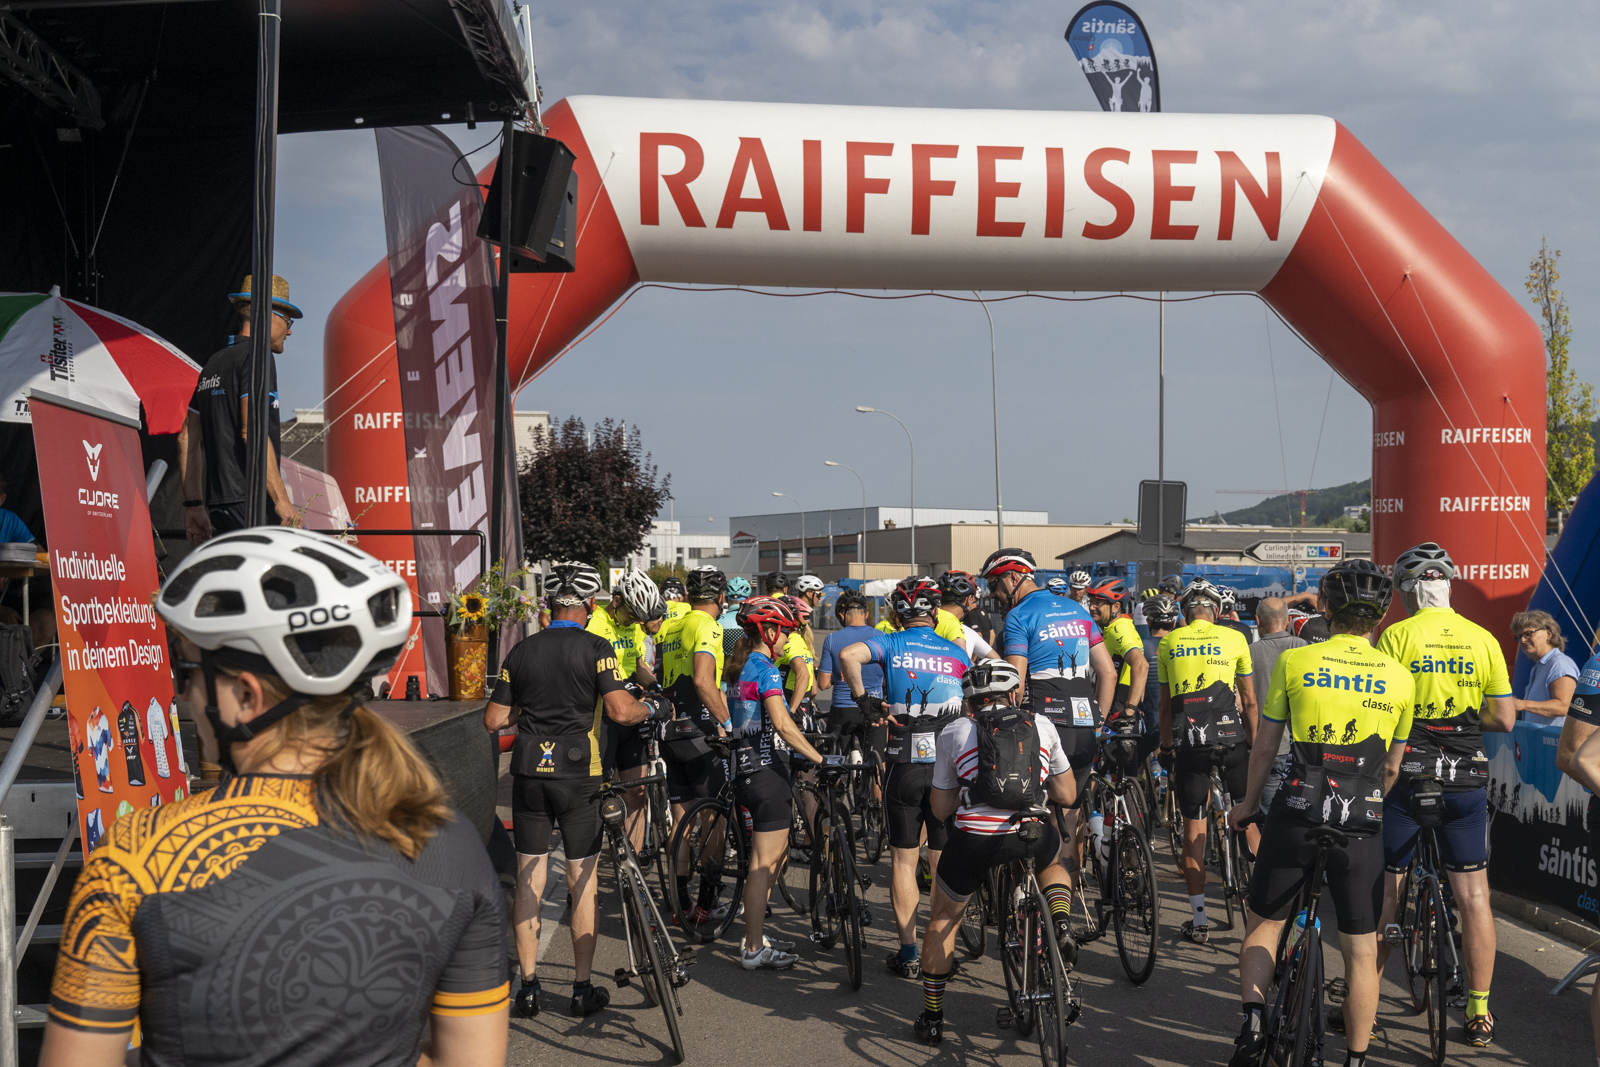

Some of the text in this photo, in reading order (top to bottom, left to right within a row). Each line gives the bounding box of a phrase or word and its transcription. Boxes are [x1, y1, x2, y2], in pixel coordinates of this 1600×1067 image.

[639, 131, 1283, 242] RAIFFEISEN
[49, 337, 69, 381] Tilsiter
[197, 374, 221, 392] säntis
[1440, 428, 1532, 444] RAIFFEISEN
[78, 488, 119, 510] CUORE
[1440, 496, 1531, 512] RAIFFEISEN
[1264, 544, 1305, 553] Curlinghalle
[55, 549, 126, 582] Individuelle
[1451, 564, 1529, 580] AIFFEISEN
[61, 595, 156, 631] Sportbekleidung
[1039, 621, 1086, 641] säntis
[663, 636, 682, 653] äntis
[1169, 643, 1221, 660] säntis
[66, 639, 164, 671] in deinem Design
[892, 652, 953, 674] säntis
[1206, 658, 1229, 667] classic
[1322, 656, 1386, 668] saentis-classic.ch
[1410, 655, 1474, 675] säntis
[1303, 667, 1387, 695] säntis
[1584, 669, 1600, 679] BIKE
[1457, 678, 1482, 688] classic
[1362, 698, 1394, 714] classic
[1323, 753, 1355, 763] SPONSER
[1538, 836, 1599, 888] säntis
